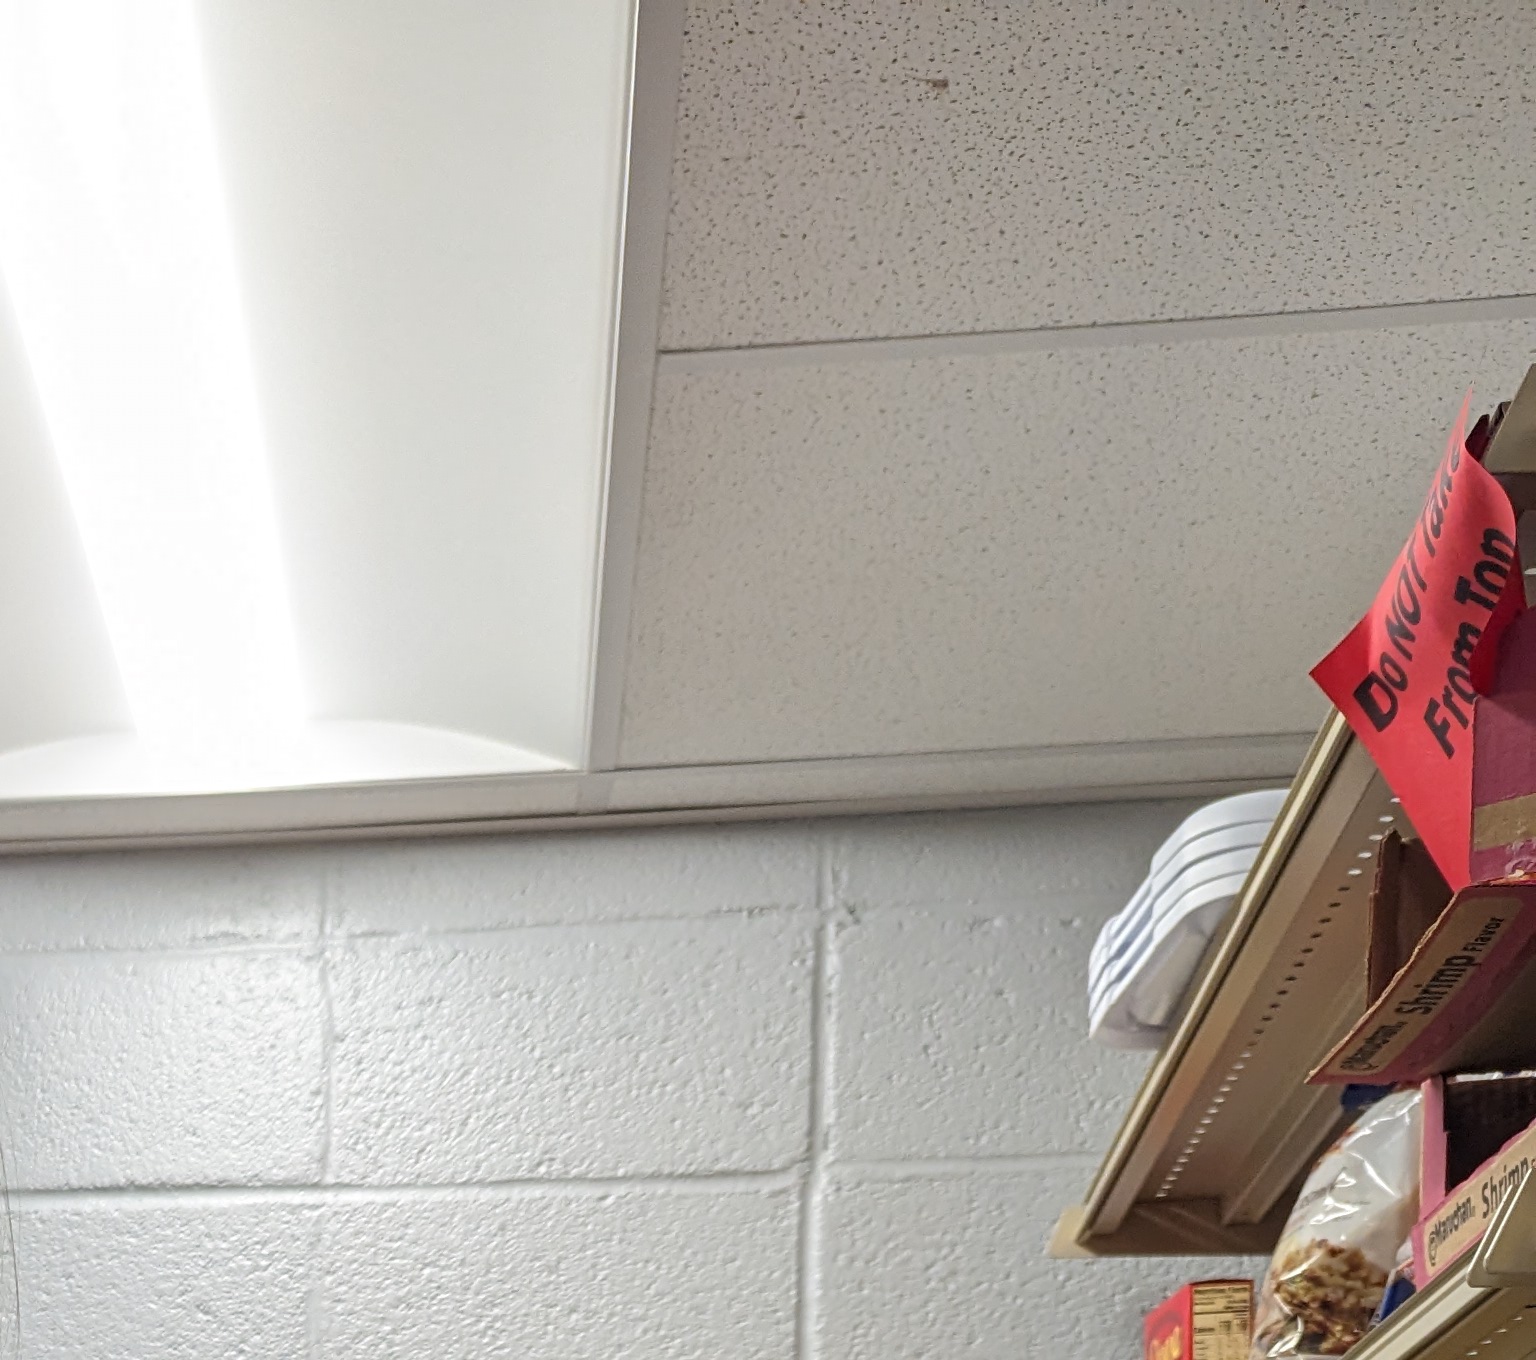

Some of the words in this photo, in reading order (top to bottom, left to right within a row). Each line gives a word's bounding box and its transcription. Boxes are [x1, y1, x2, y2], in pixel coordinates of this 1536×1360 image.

[1352, 652, 1408, 733] Do
[1385, 538, 1428, 662] NOT
[1423, 621, 1481, 760] From
[1395, 955, 1483, 1015] Shrimp
[1462, 916, 1505, 954] Flavor
